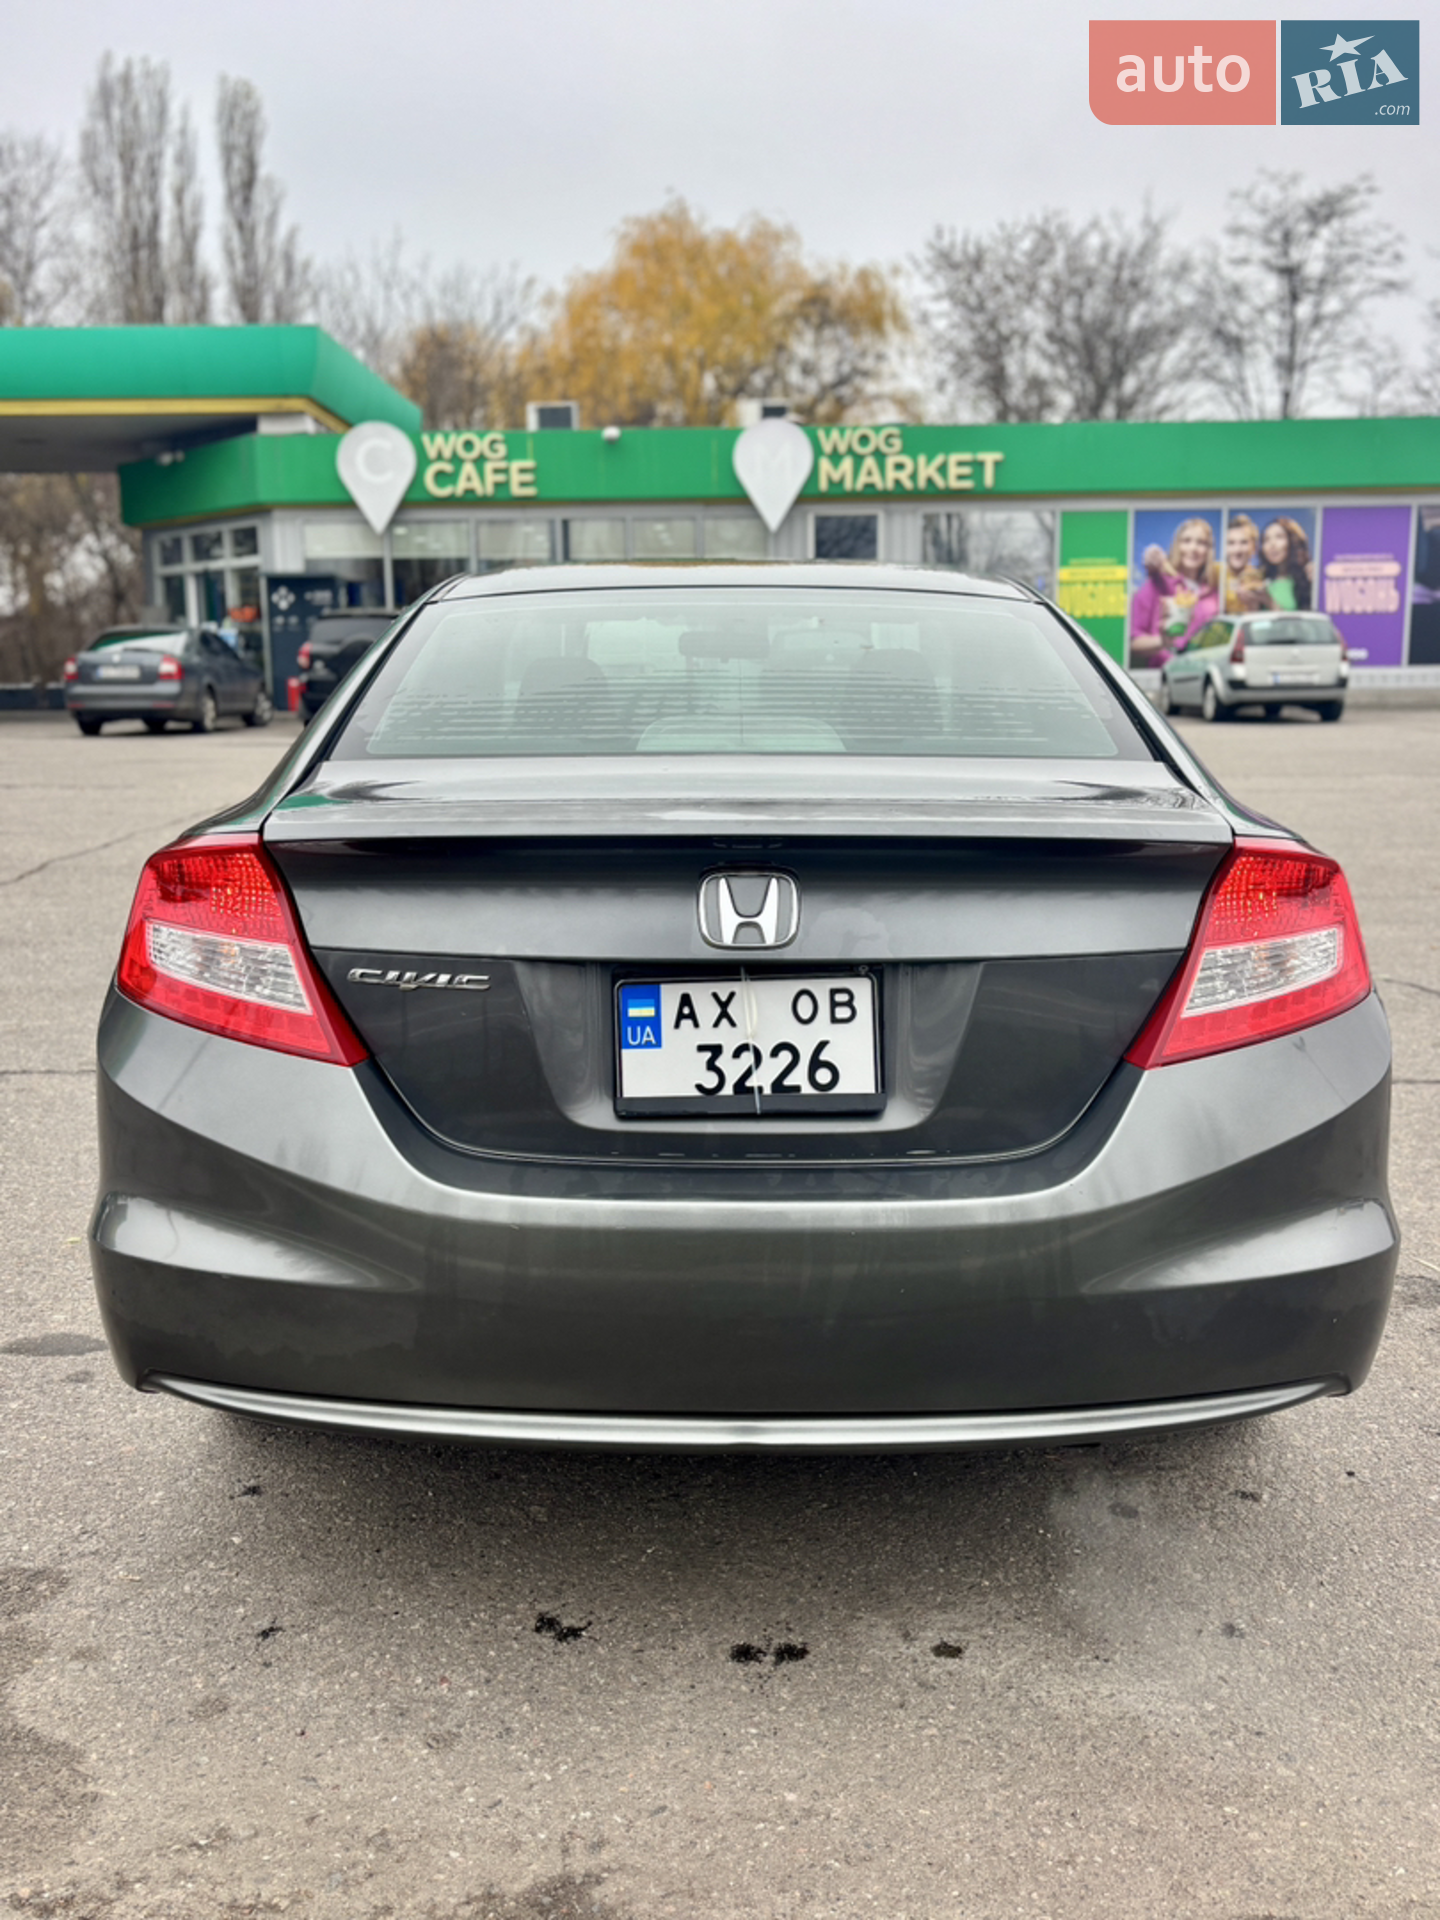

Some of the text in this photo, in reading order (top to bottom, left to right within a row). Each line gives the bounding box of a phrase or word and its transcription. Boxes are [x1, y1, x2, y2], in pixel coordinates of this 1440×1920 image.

[421, 432, 507, 461] WOG
[817, 427, 902, 456] WOG
[423, 460, 538, 498] CAFE
[818, 451, 1004, 492] MARKET
[347, 967, 492, 991] CIVIC
[673, 991, 737, 1030] AX
[627, 1026, 657, 1046] UA
[694, 1040, 840, 1096] 3226
